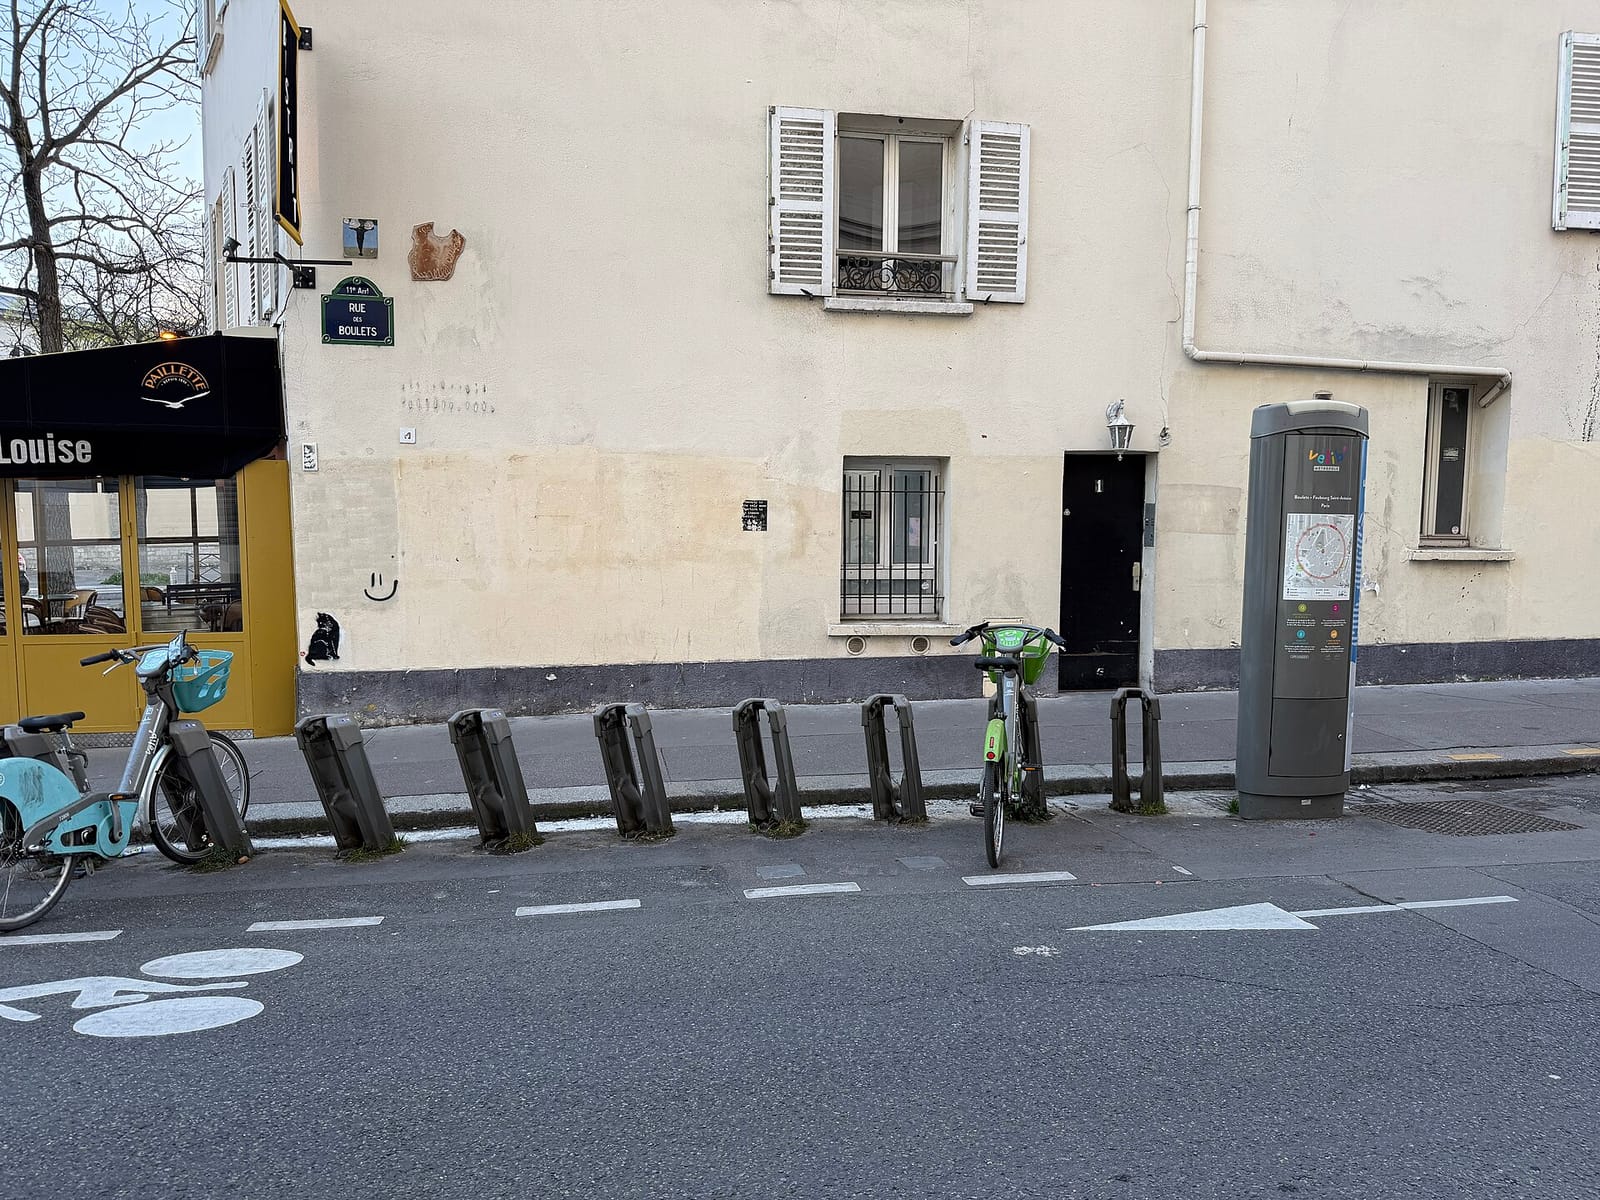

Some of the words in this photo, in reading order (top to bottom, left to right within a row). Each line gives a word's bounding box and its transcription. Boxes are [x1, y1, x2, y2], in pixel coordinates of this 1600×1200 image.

[349, 303, 366, 313] RUE
[338, 325, 377, 337] BOULETS
[144, 365, 207, 391] PAILLETTE
[0, 432, 92, 464] Louise
[1096, 479, 1103, 493] 1
